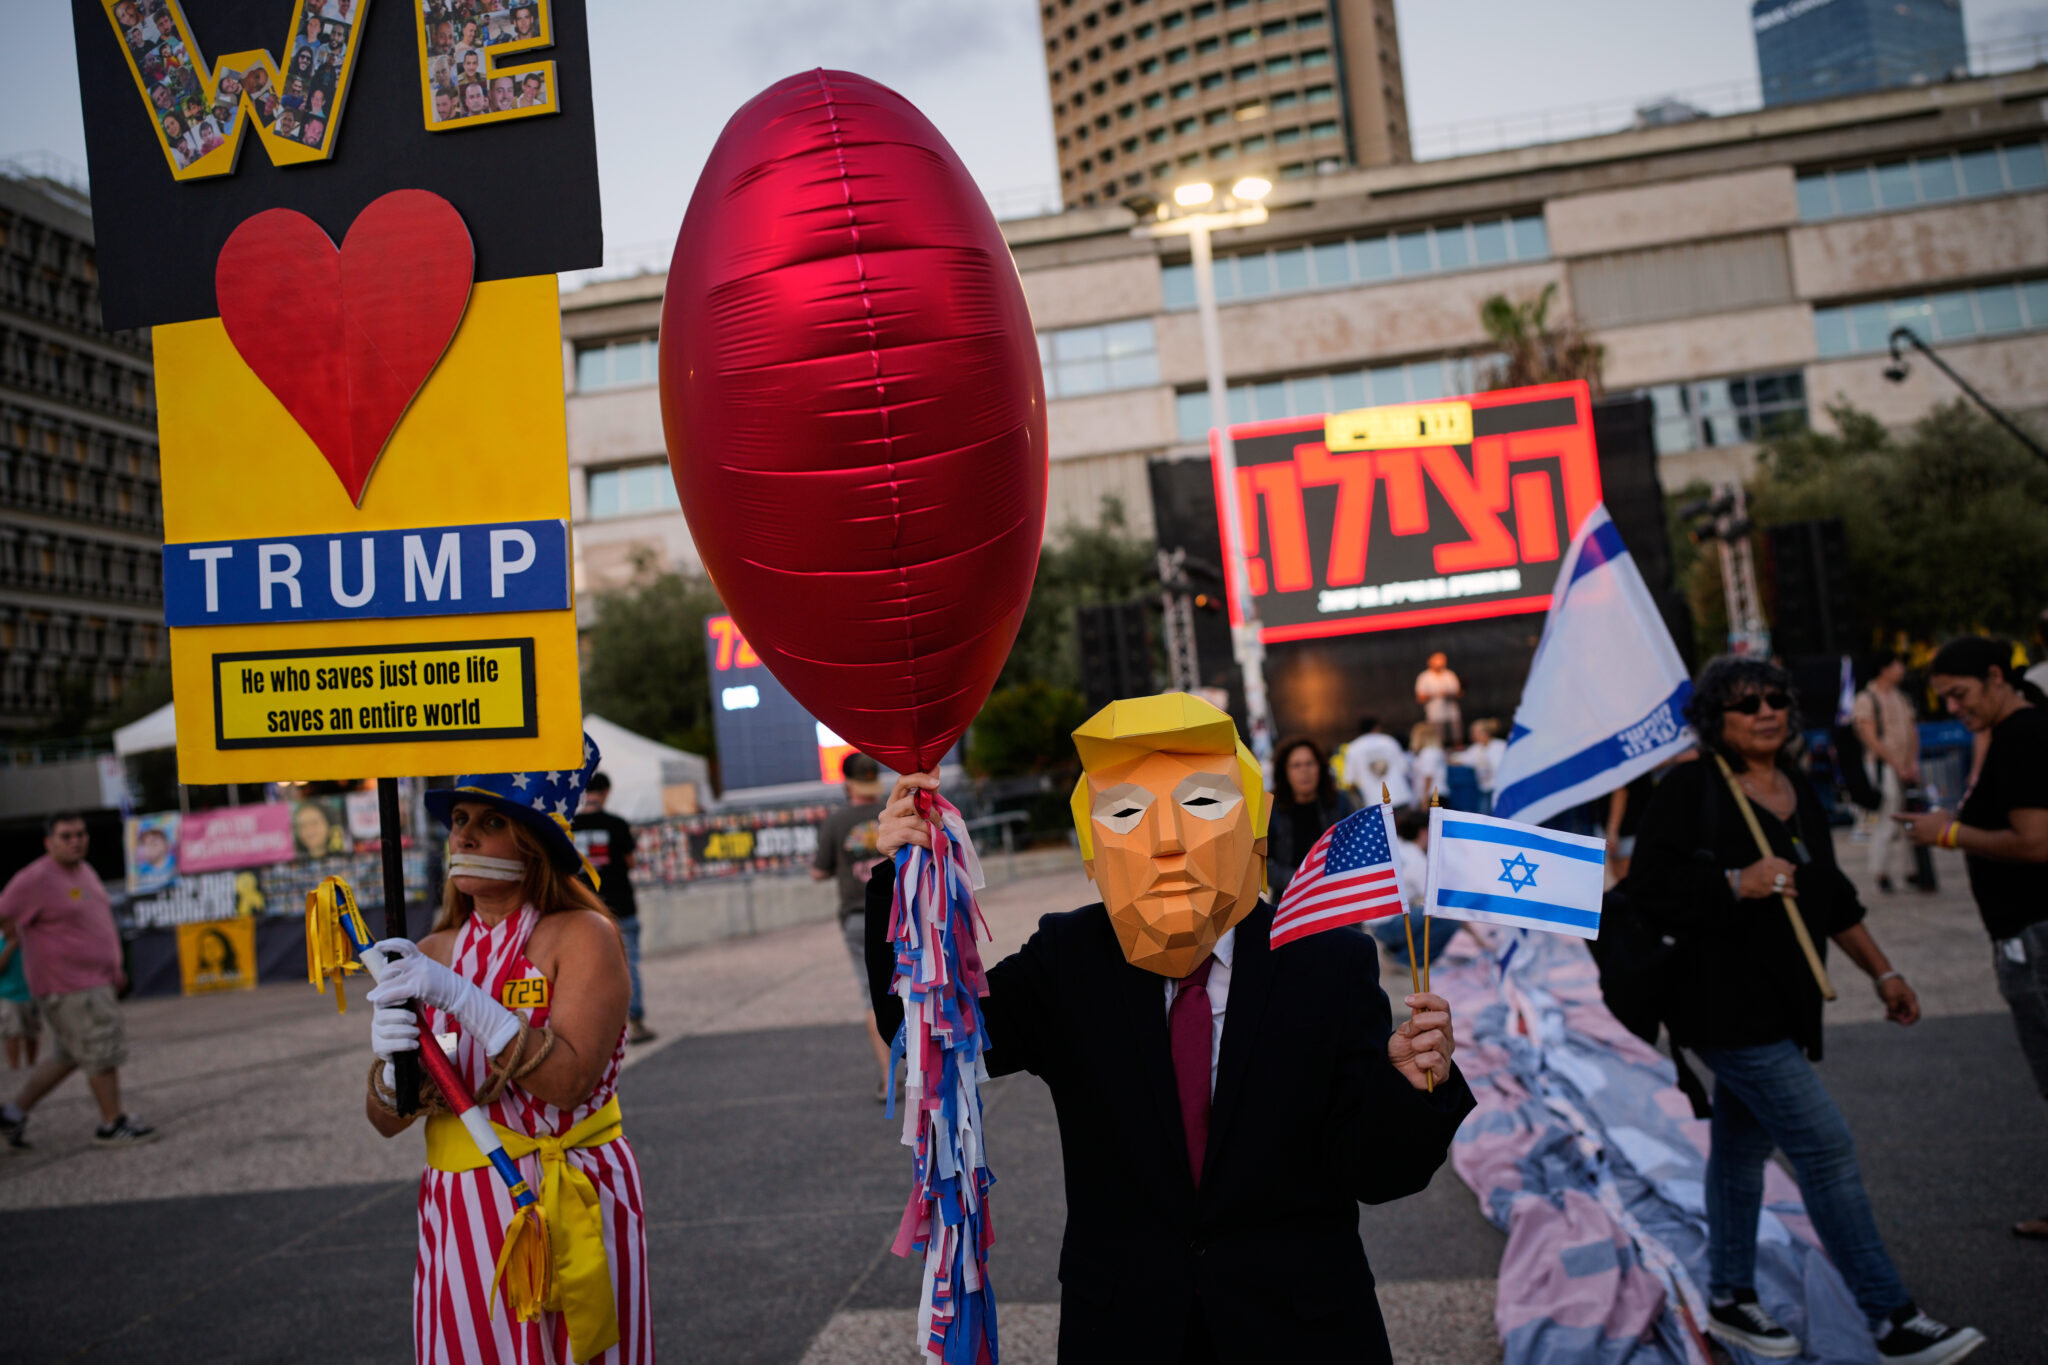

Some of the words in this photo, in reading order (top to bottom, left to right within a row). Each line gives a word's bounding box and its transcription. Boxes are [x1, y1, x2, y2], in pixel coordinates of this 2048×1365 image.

[106, 0, 561, 182] WE
[188, 527, 538, 613] TRUMP
[241, 668, 265, 694] He
[270, 666, 311, 693] who
[316, 664, 374, 691] saves
[379, 659, 418, 690] just
[423, 660, 461, 686] one
[466, 655, 499, 684] life
[267, 707, 324, 733] saves
[329, 706, 354, 731] an
[359, 701, 418, 730] entire
[423, 698, 481, 727] world
[505, 978, 545, 1005] 729
